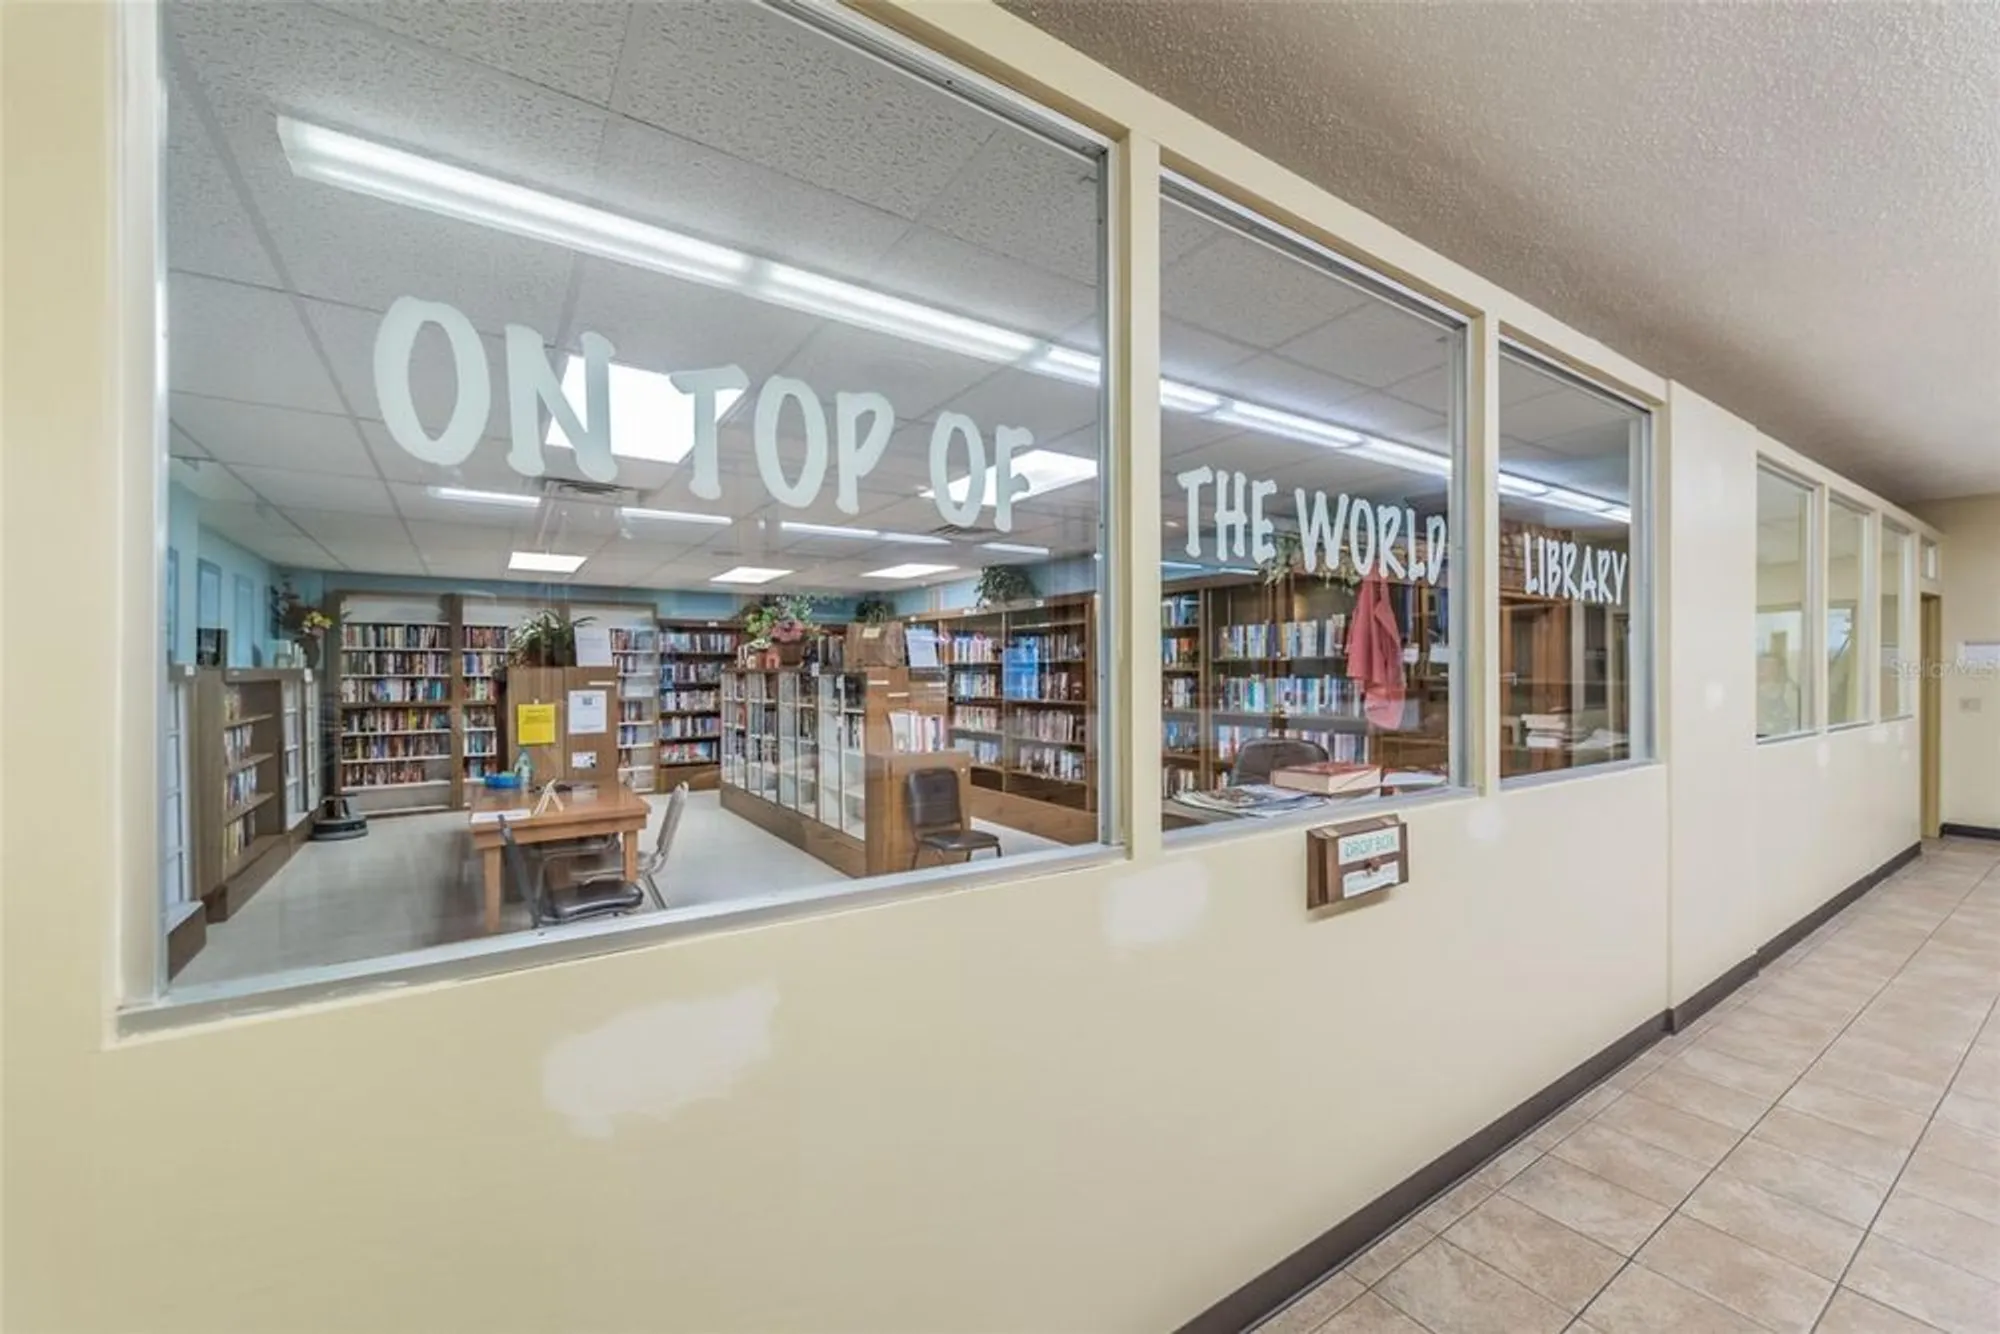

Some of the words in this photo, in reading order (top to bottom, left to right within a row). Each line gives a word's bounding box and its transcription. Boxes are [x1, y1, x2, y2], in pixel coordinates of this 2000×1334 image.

[373, 296, 617, 483] ON
[669, 363, 895, 514] TOP
[929, 411, 1035, 532] OF
[1177, 465, 1277, 563] THE
[1295, 487, 1446, 585] WORLD
[1523, 531, 1627, 605] LIBRARY
